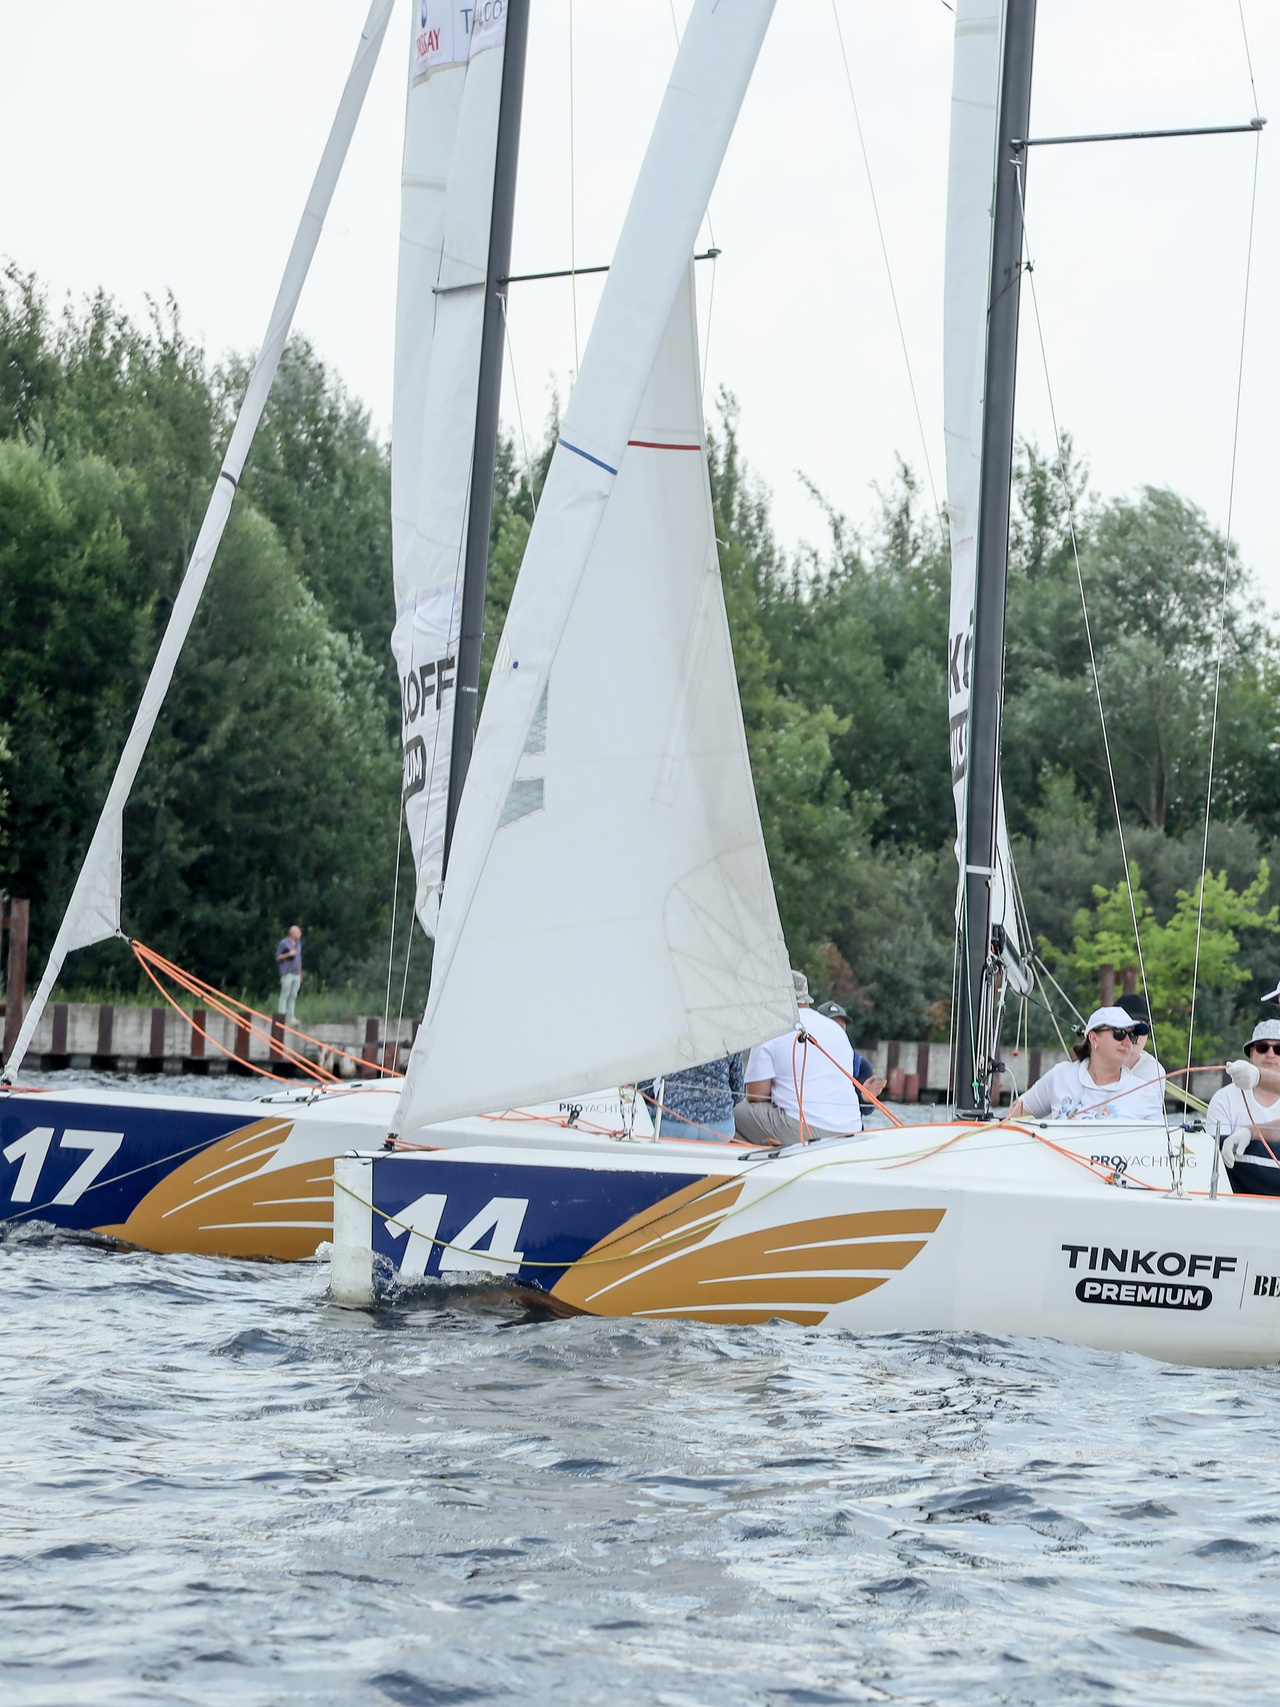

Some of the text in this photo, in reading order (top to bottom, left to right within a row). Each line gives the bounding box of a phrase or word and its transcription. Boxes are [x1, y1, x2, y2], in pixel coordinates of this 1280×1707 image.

[559, 1102, 639, 1115] PROYACHTNG
[2, 1126, 125, 1206] 17
[1090, 1154, 1197, 1169] PROYACHTNG
[384, 1193, 529, 1277] 14
[1061, 1244, 1238, 1279] TINKOFF
[1083, 1281, 1205, 1307] PREMIUM
